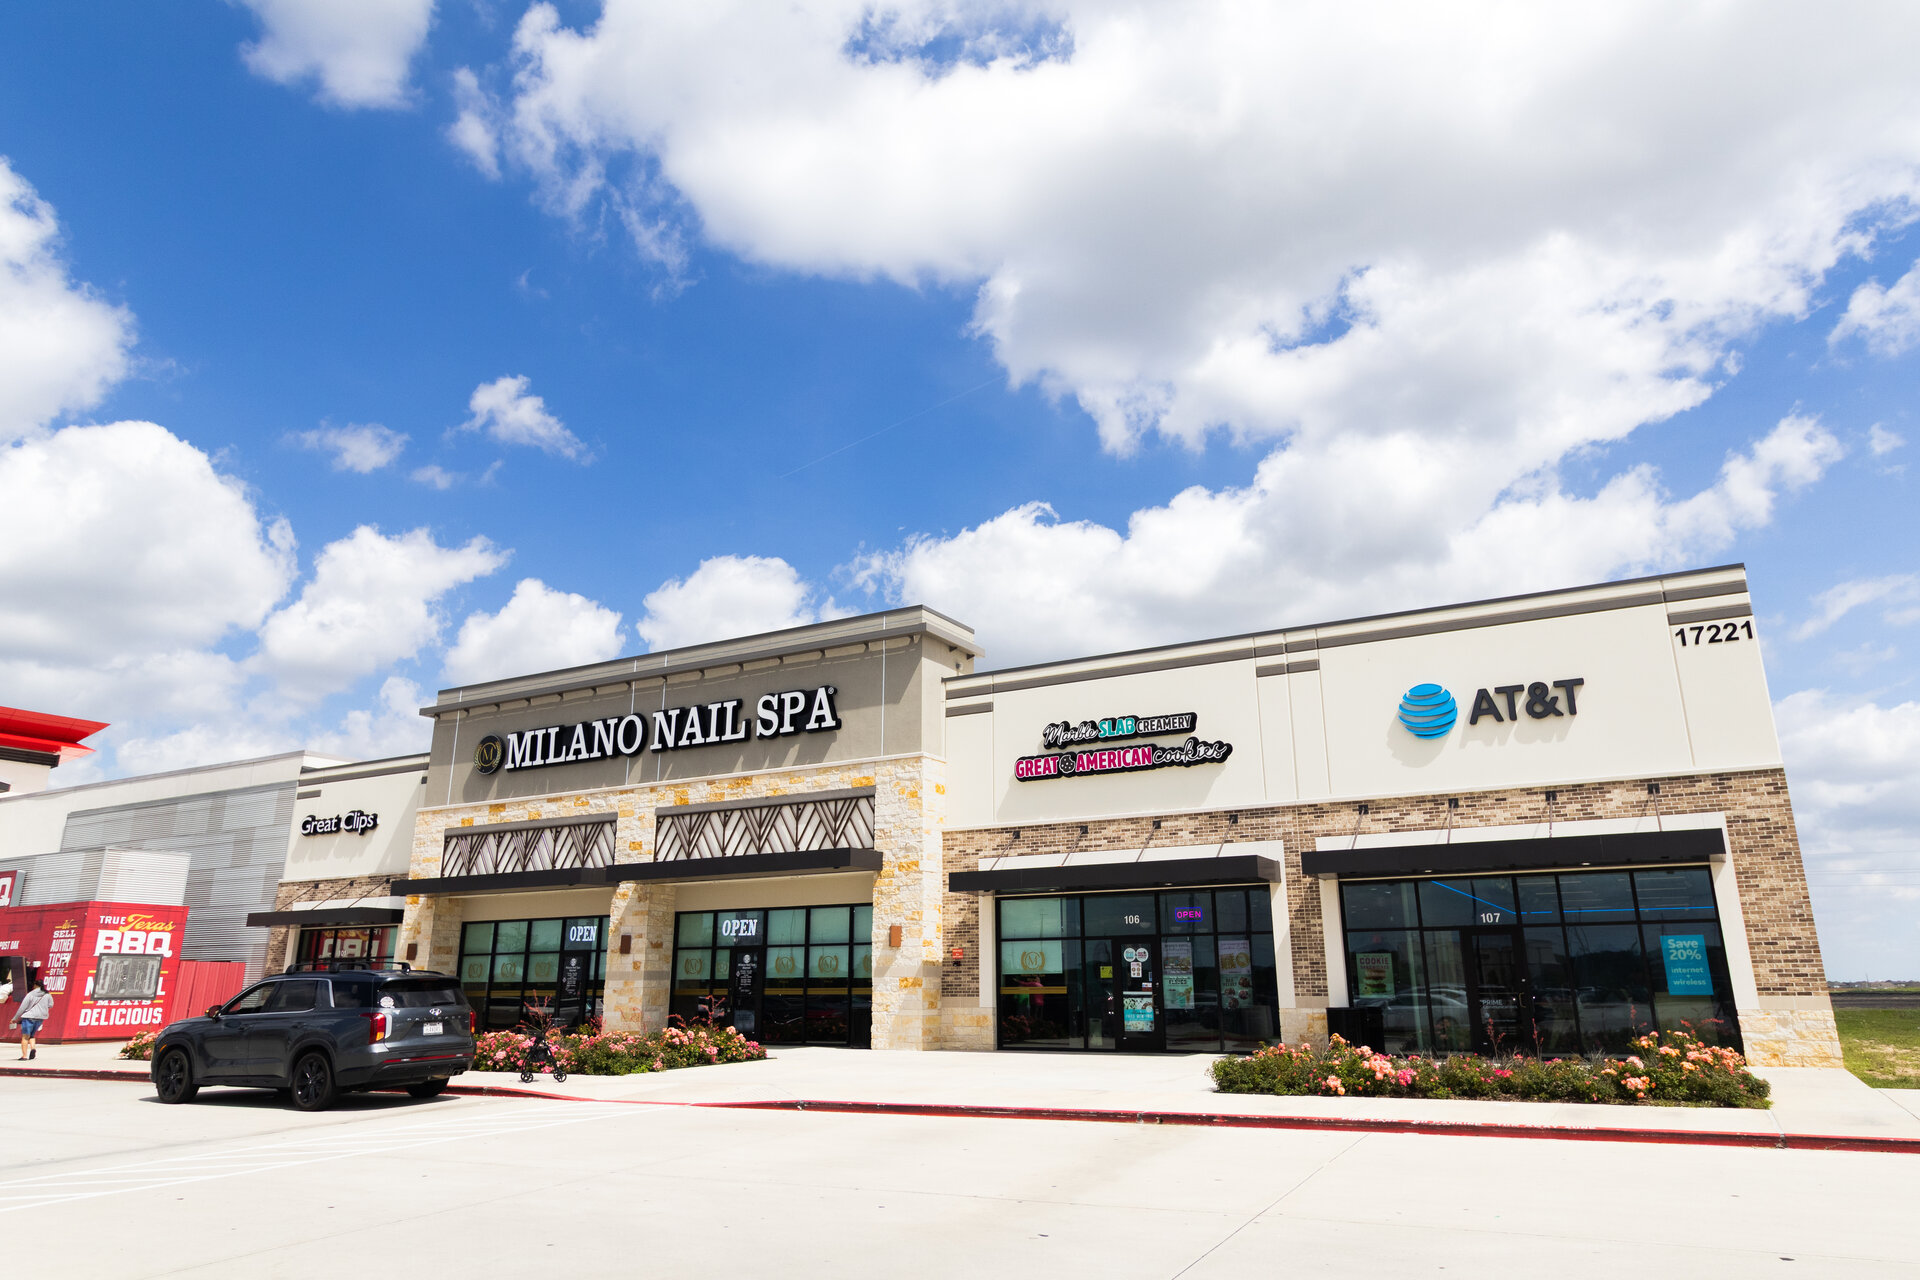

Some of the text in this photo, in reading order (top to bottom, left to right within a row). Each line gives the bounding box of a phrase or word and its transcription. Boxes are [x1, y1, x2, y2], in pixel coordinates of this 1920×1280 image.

[1675, 621, 1753, 647] 17221
[1469, 678, 1584, 726] AT&T
[504, 714, 643, 769] MILANO
[650, 700, 747, 750] NAIL
[1043, 715, 1191, 745] Marble SLAB CREAMERY
[1015, 740, 1227, 778] GREAT AMERICAN cookies
[301, 812, 375, 835] Great Clips
[99, 914, 176, 932] TRUE Texas
[1124, 915, 1140, 924] 106
[1480, 913, 1500, 923] 107
[53, 930, 76, 938] SELL
[569, 925, 597, 942] OPEN
[722, 919, 757, 936] OPEN
[50, 939, 75, 952] AUTHEN
[93, 930, 173, 958] BBQ
[1667, 939, 1698, 948] Save
[1359, 957, 1389, 965] COOKIE
[1669, 949, 1702, 960] 20%
[43, 976, 67, 991] POUND
[78, 1008, 164, 1026] DELICIOUS
